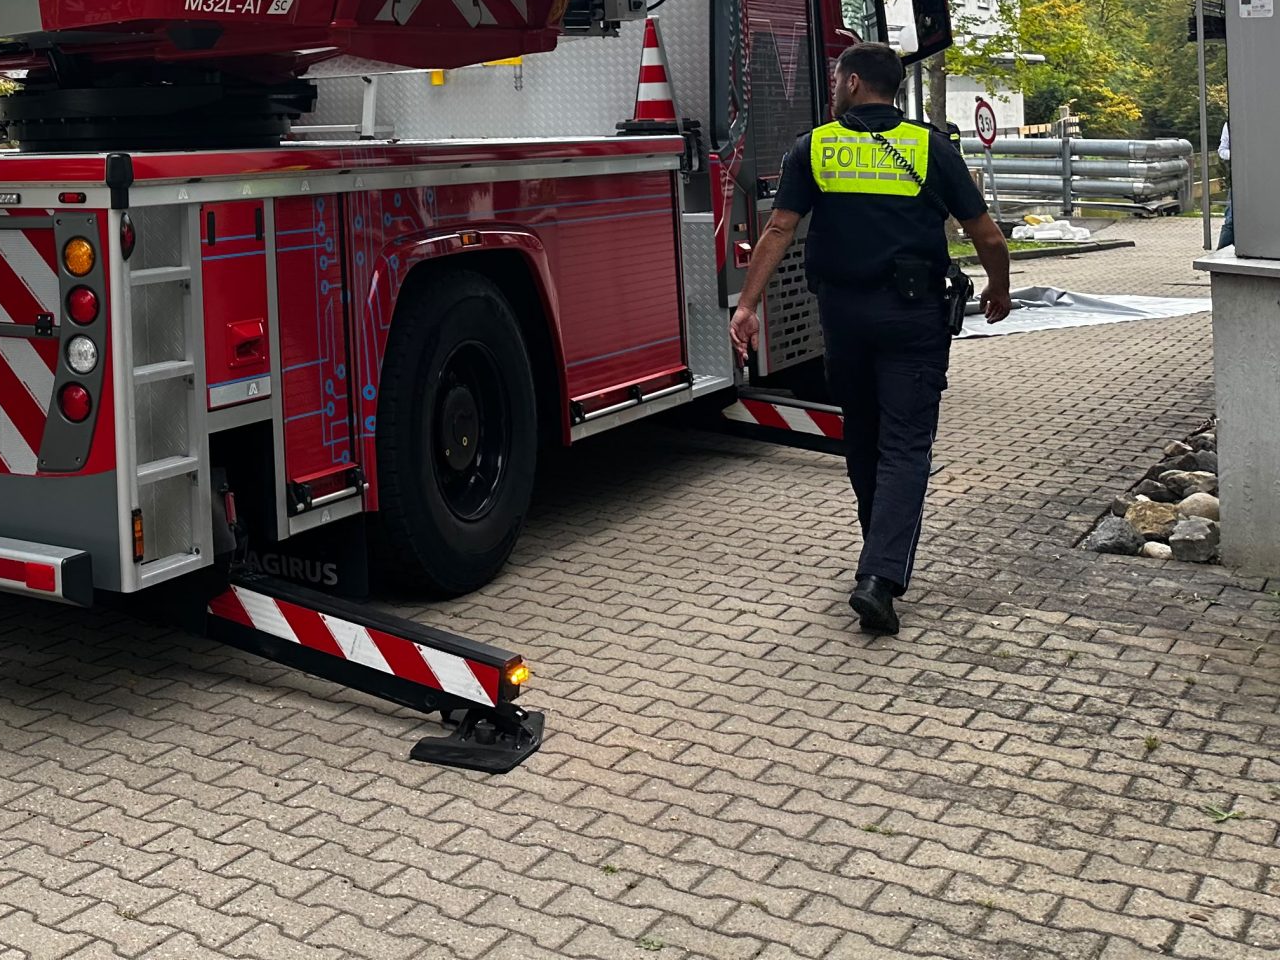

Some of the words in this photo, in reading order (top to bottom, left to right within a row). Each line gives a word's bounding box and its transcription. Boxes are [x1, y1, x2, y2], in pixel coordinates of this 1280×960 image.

[274, 1, 288, 12] SC
[821, 146, 915, 170] POLIZEI
[246, 550, 338, 586] AGIRUS
